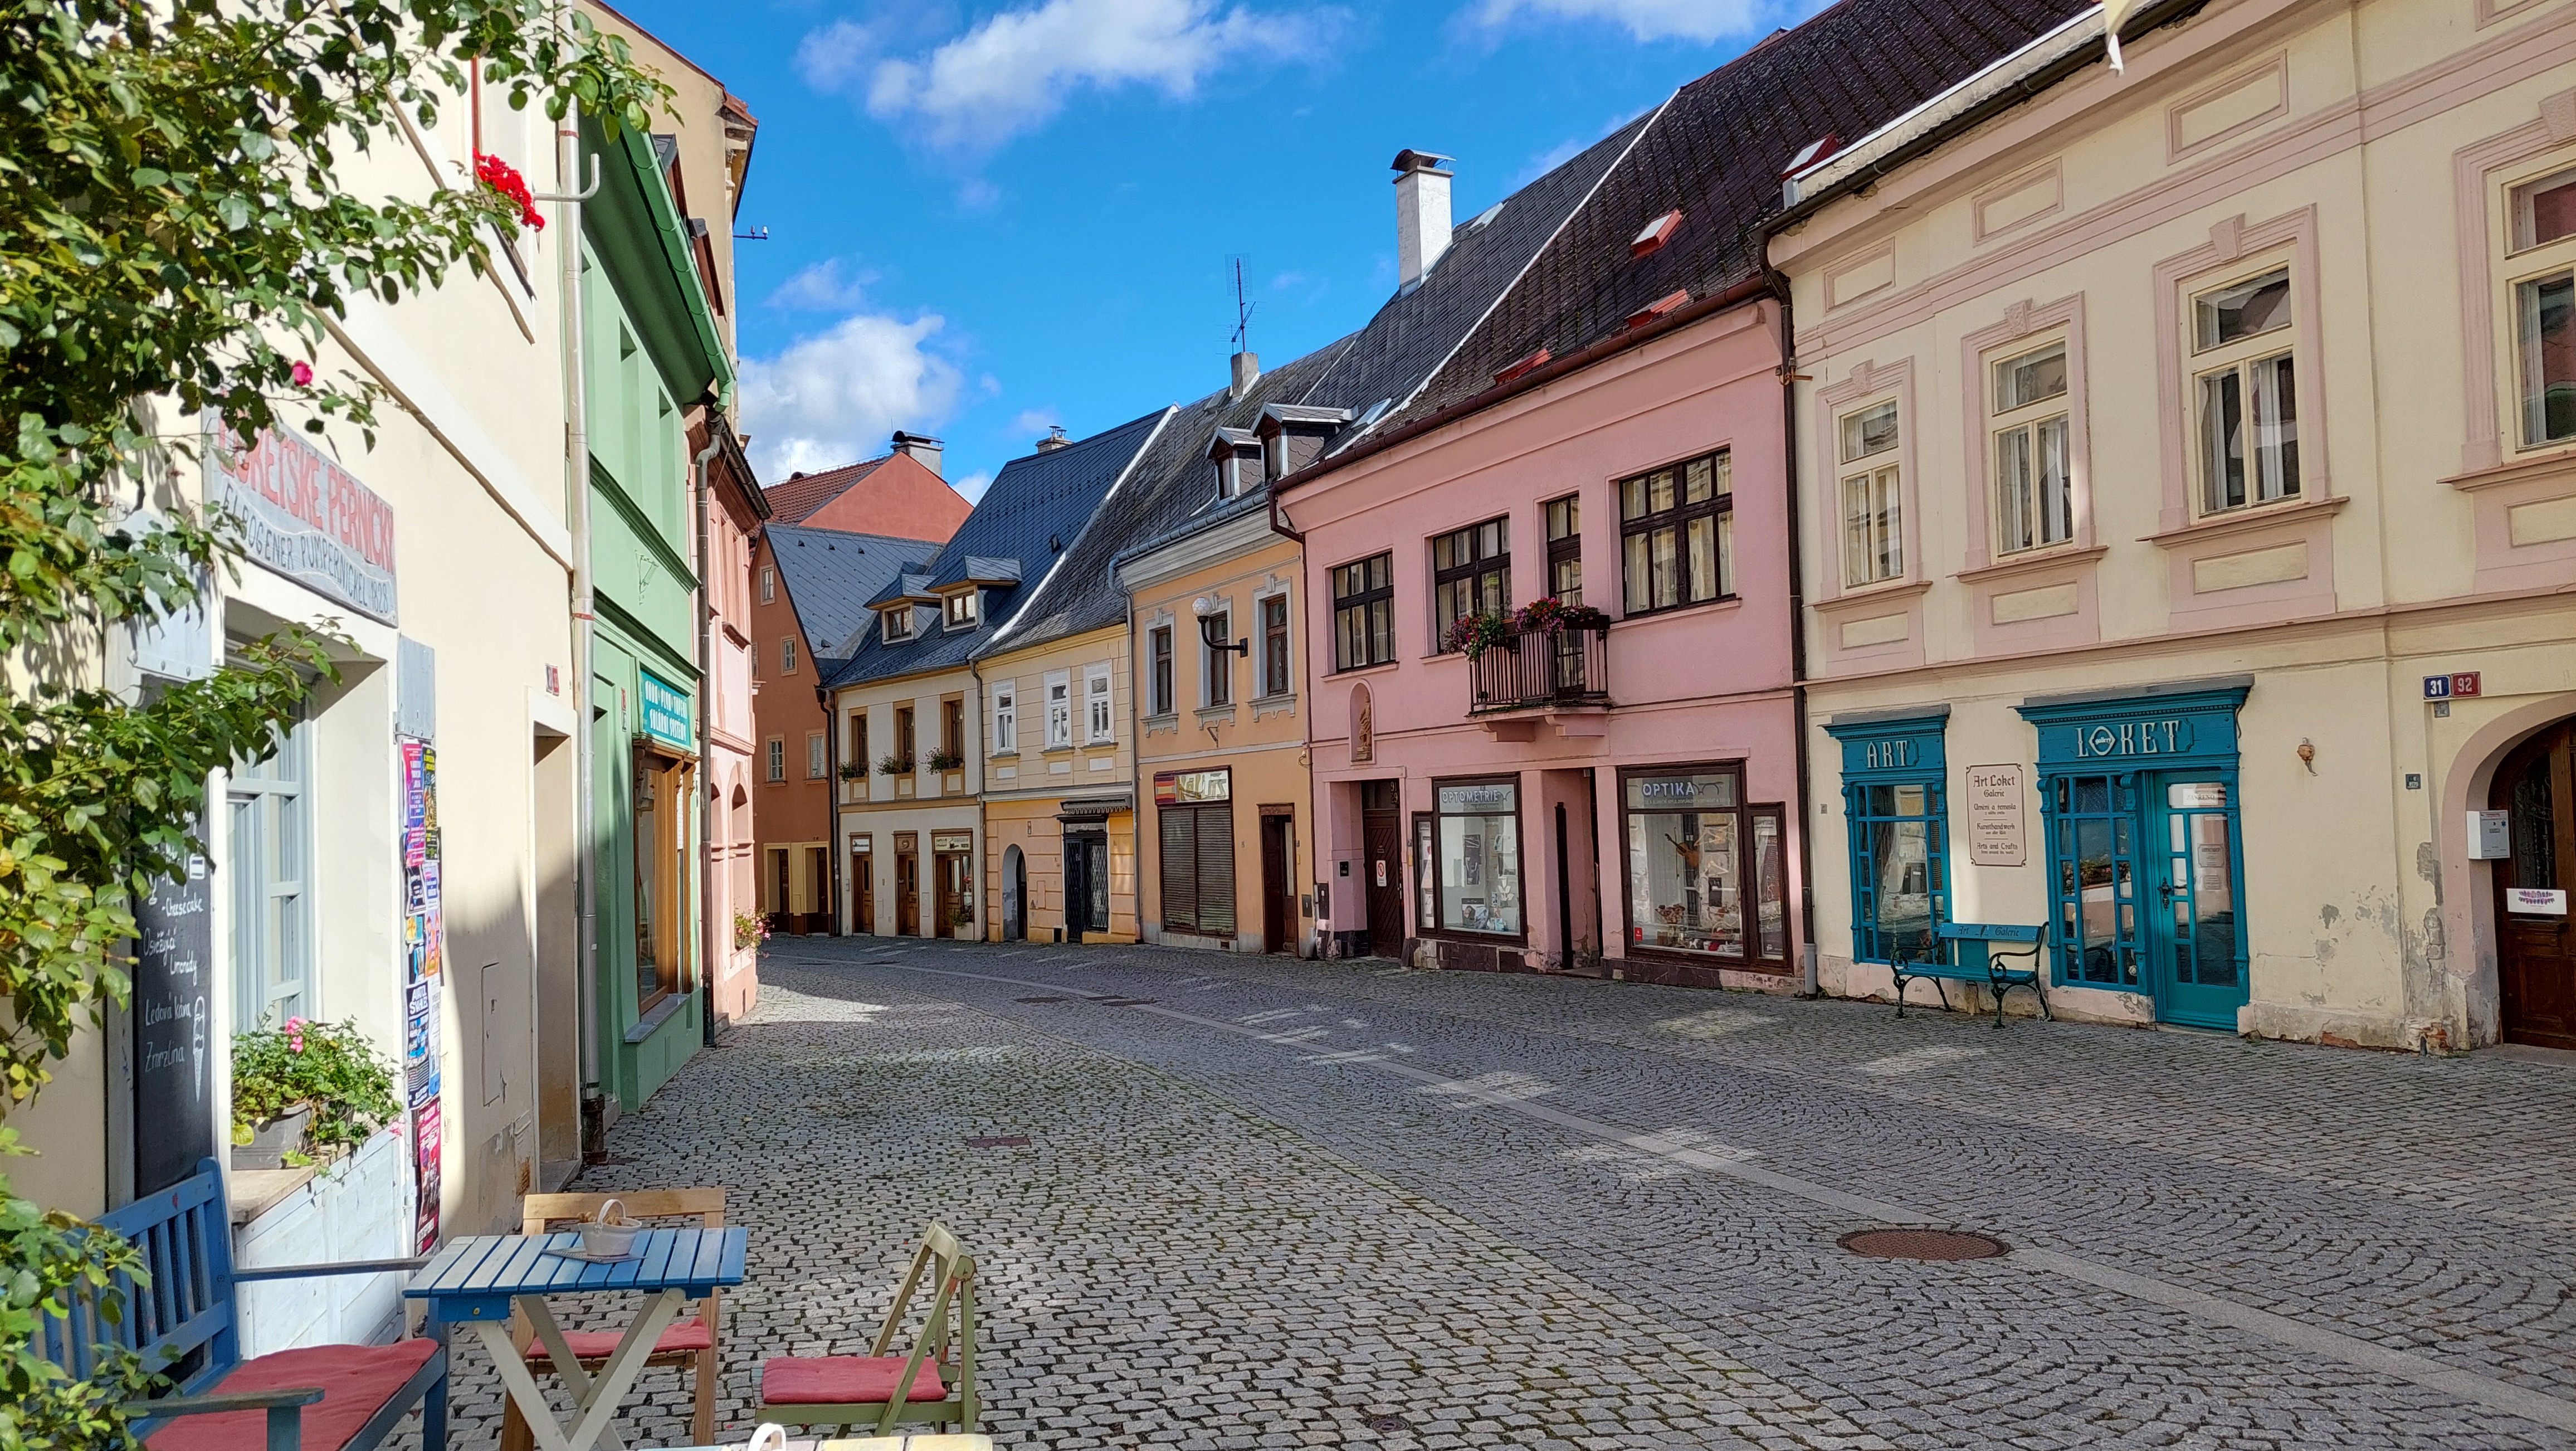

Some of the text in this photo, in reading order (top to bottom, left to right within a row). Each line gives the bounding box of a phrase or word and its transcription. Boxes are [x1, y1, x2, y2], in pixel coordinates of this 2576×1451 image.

[300, 534, 368, 607] PUMPERNICKEL
[370, 582, 389, 615] 1828
[2430, 677, 2472, 695] 31 92
[2075, 720, 2180, 758] LOKET
[1866, 740, 1909, 768] ART
[1642, 781, 1695, 797] OPTIKA
[1973, 774, 2016, 787] Art Loket
[1442, 789, 1499, 804] OPTOMETRIE
[1983, 789, 2005, 797] Galerie
[2001, 842, 2018, 850] Crafts
[1957, 926, 2020, 937] Art Galerie
[145, 992, 192, 1026] Ledová káva
[145, 1040, 185, 1073] Zmrzlina
